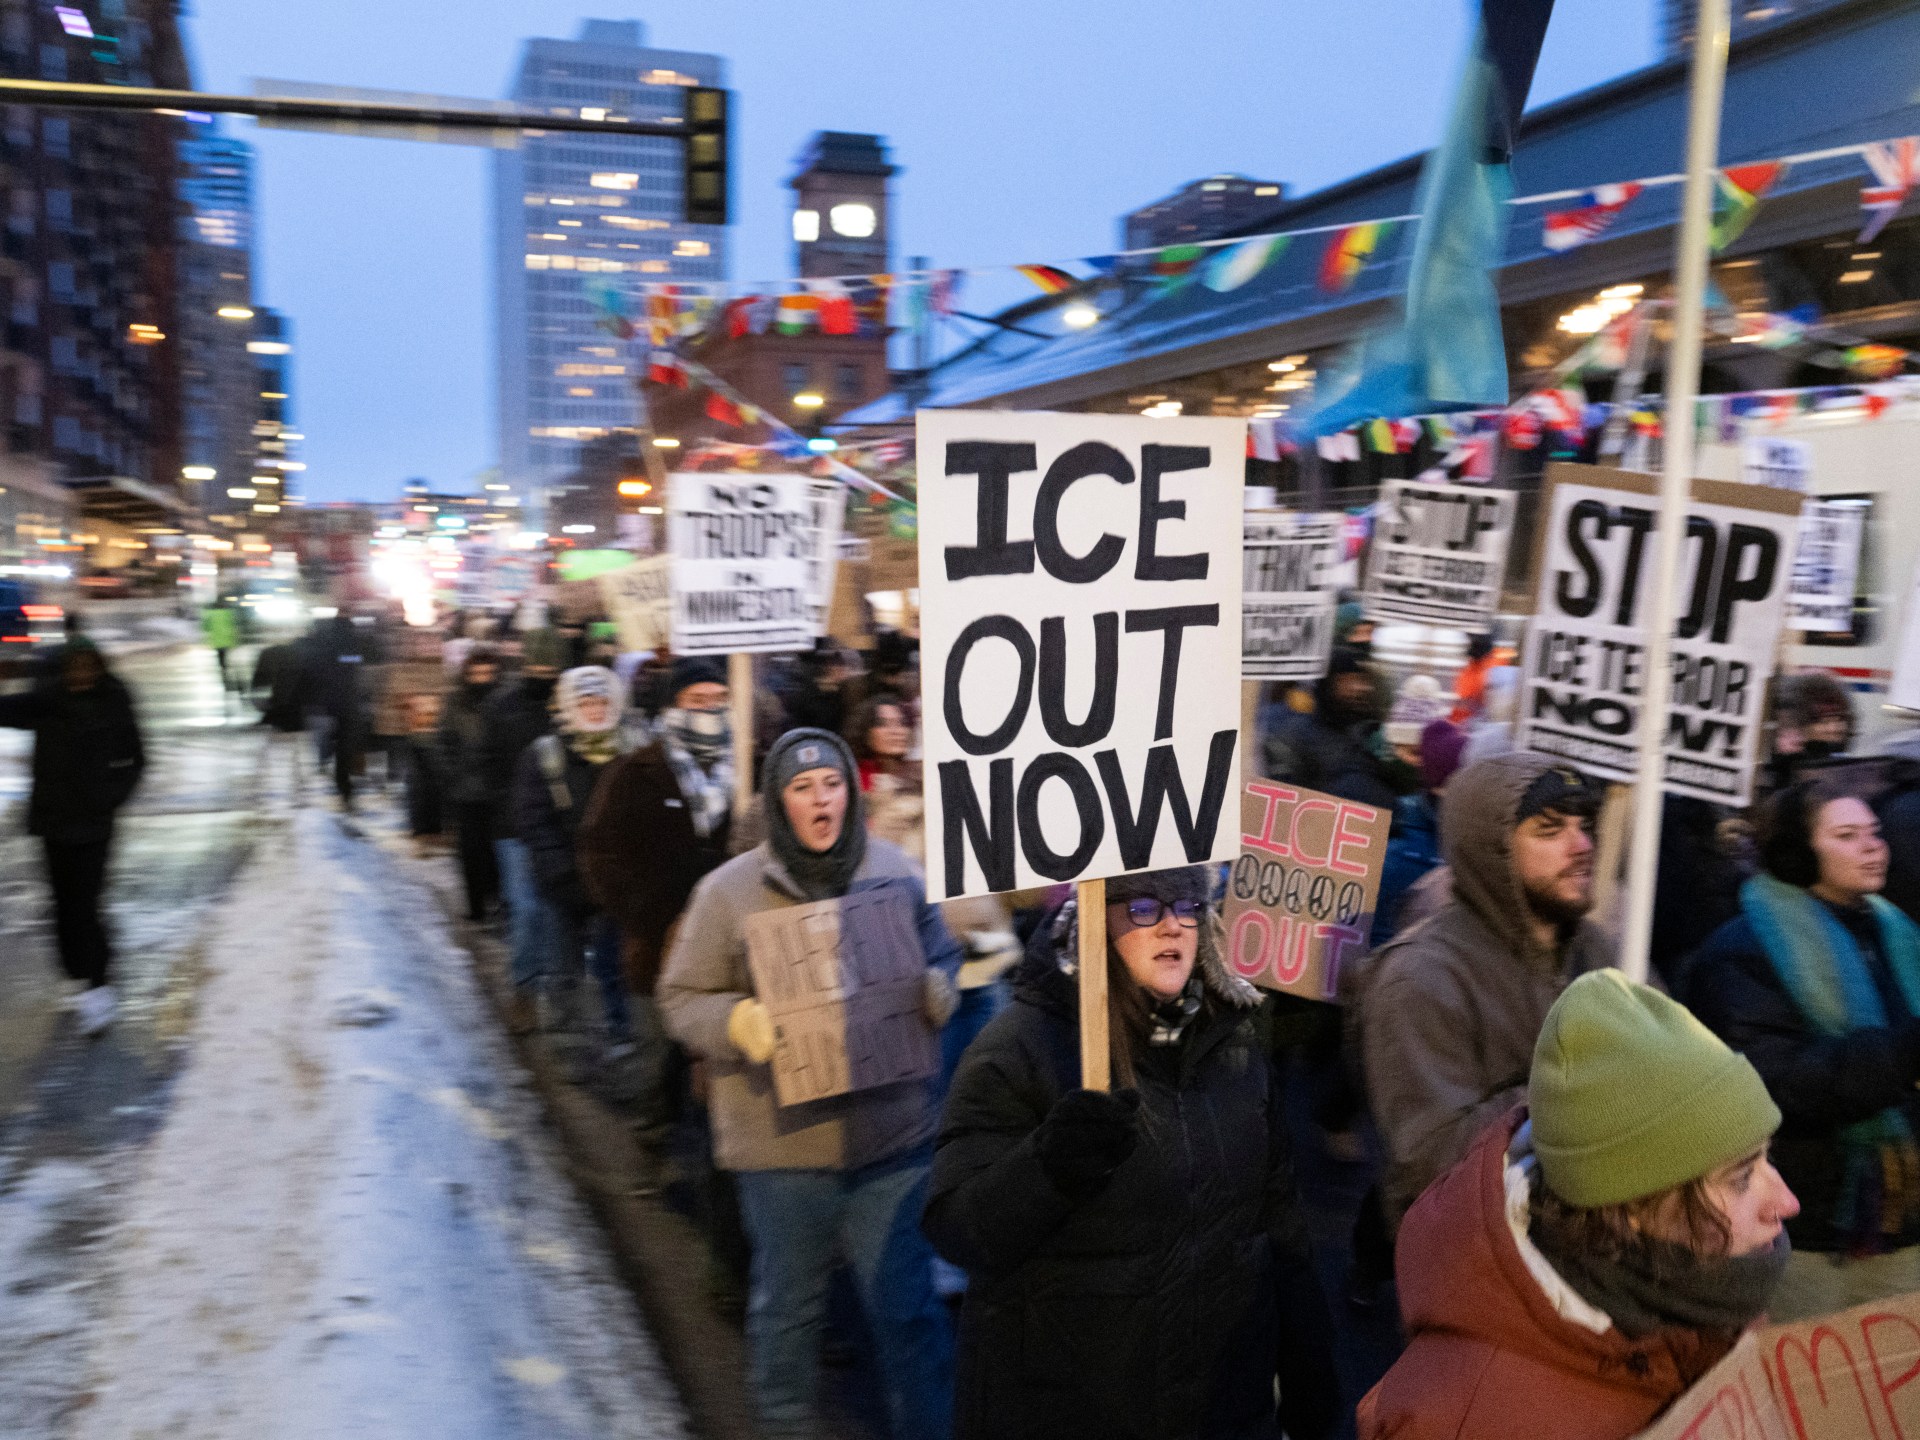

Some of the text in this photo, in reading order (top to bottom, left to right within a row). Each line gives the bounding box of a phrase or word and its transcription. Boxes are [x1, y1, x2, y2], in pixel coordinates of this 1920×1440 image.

[708, 484, 775, 509] NO
[944, 440, 1211, 584] ICE
[1386, 487, 1499, 550] STOP
[1554, 499, 1781, 644] STOP
[943, 602, 1220, 756] OUT
[1537, 630, 1752, 717] ICE TEROR
[938, 729, 1238, 898] NOW
[1240, 782, 1378, 877] ICE
[1226, 909, 1364, 998] OUT
